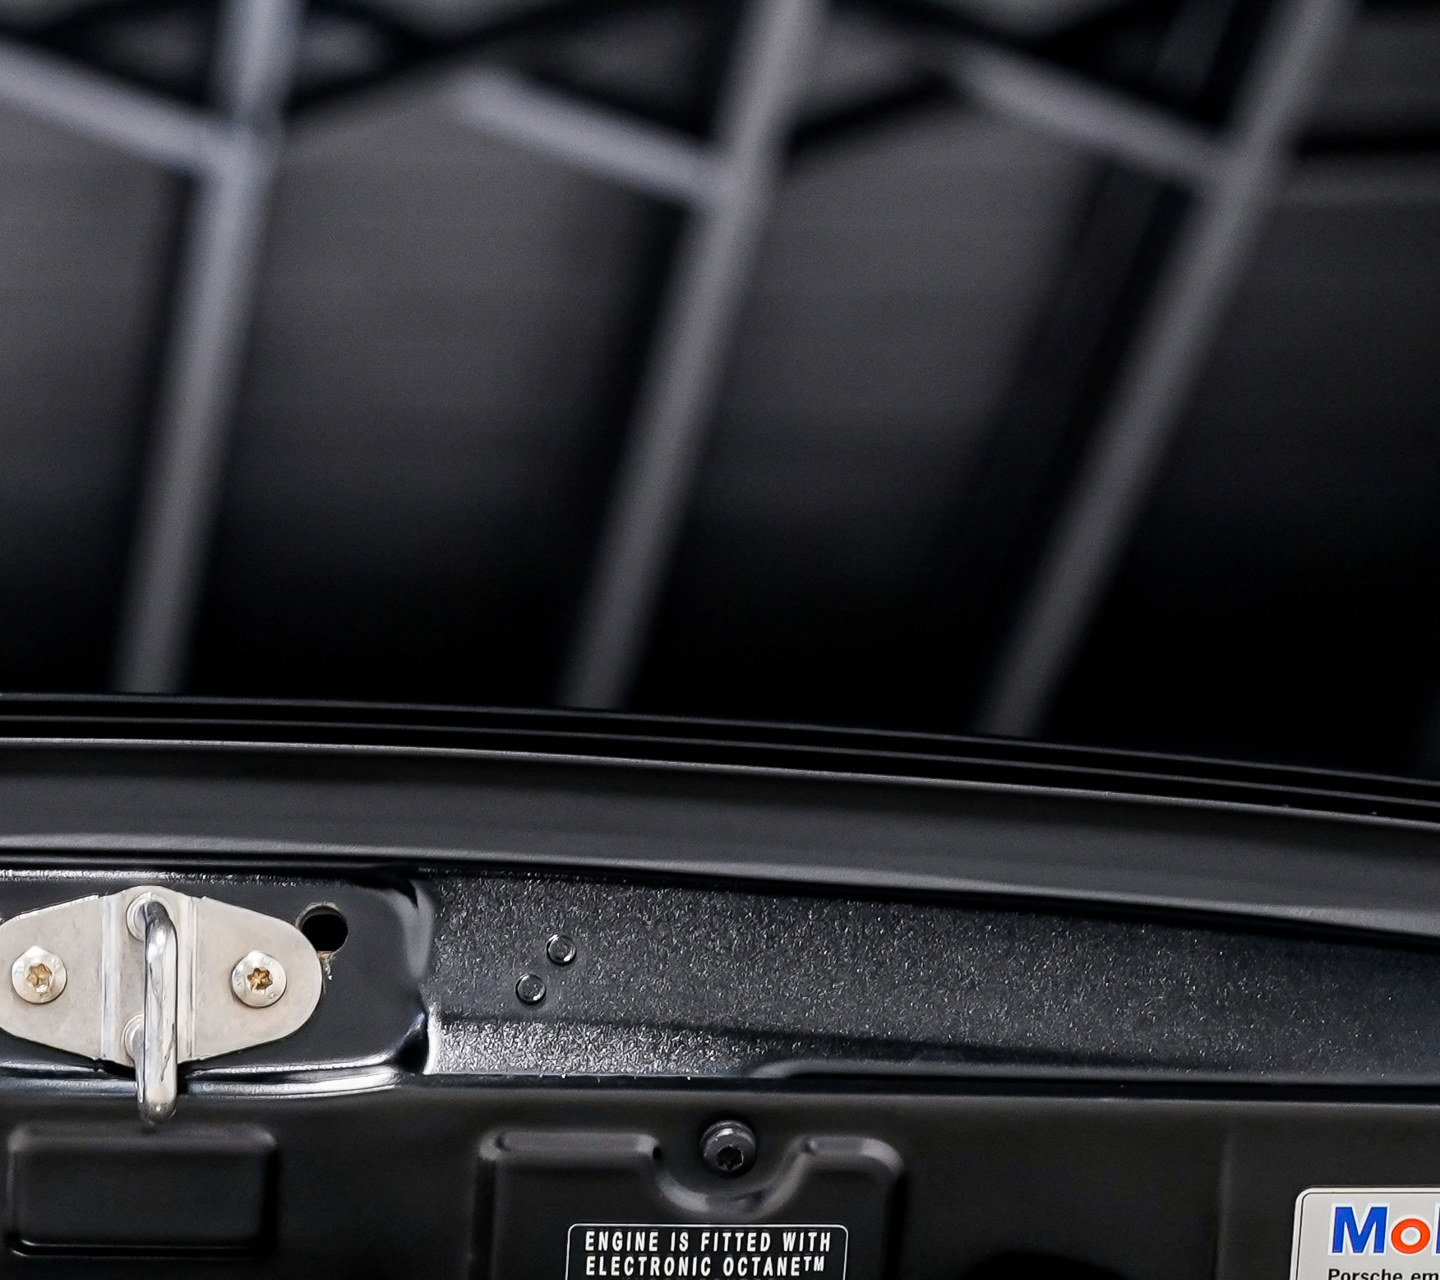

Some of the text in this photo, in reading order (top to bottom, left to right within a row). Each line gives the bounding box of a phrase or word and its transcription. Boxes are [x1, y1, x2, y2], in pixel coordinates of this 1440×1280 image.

[585, 1231, 831, 1252] ENGINE IS FITTED WITH
[586, 1256, 711, 1276] ELECTRONIC
